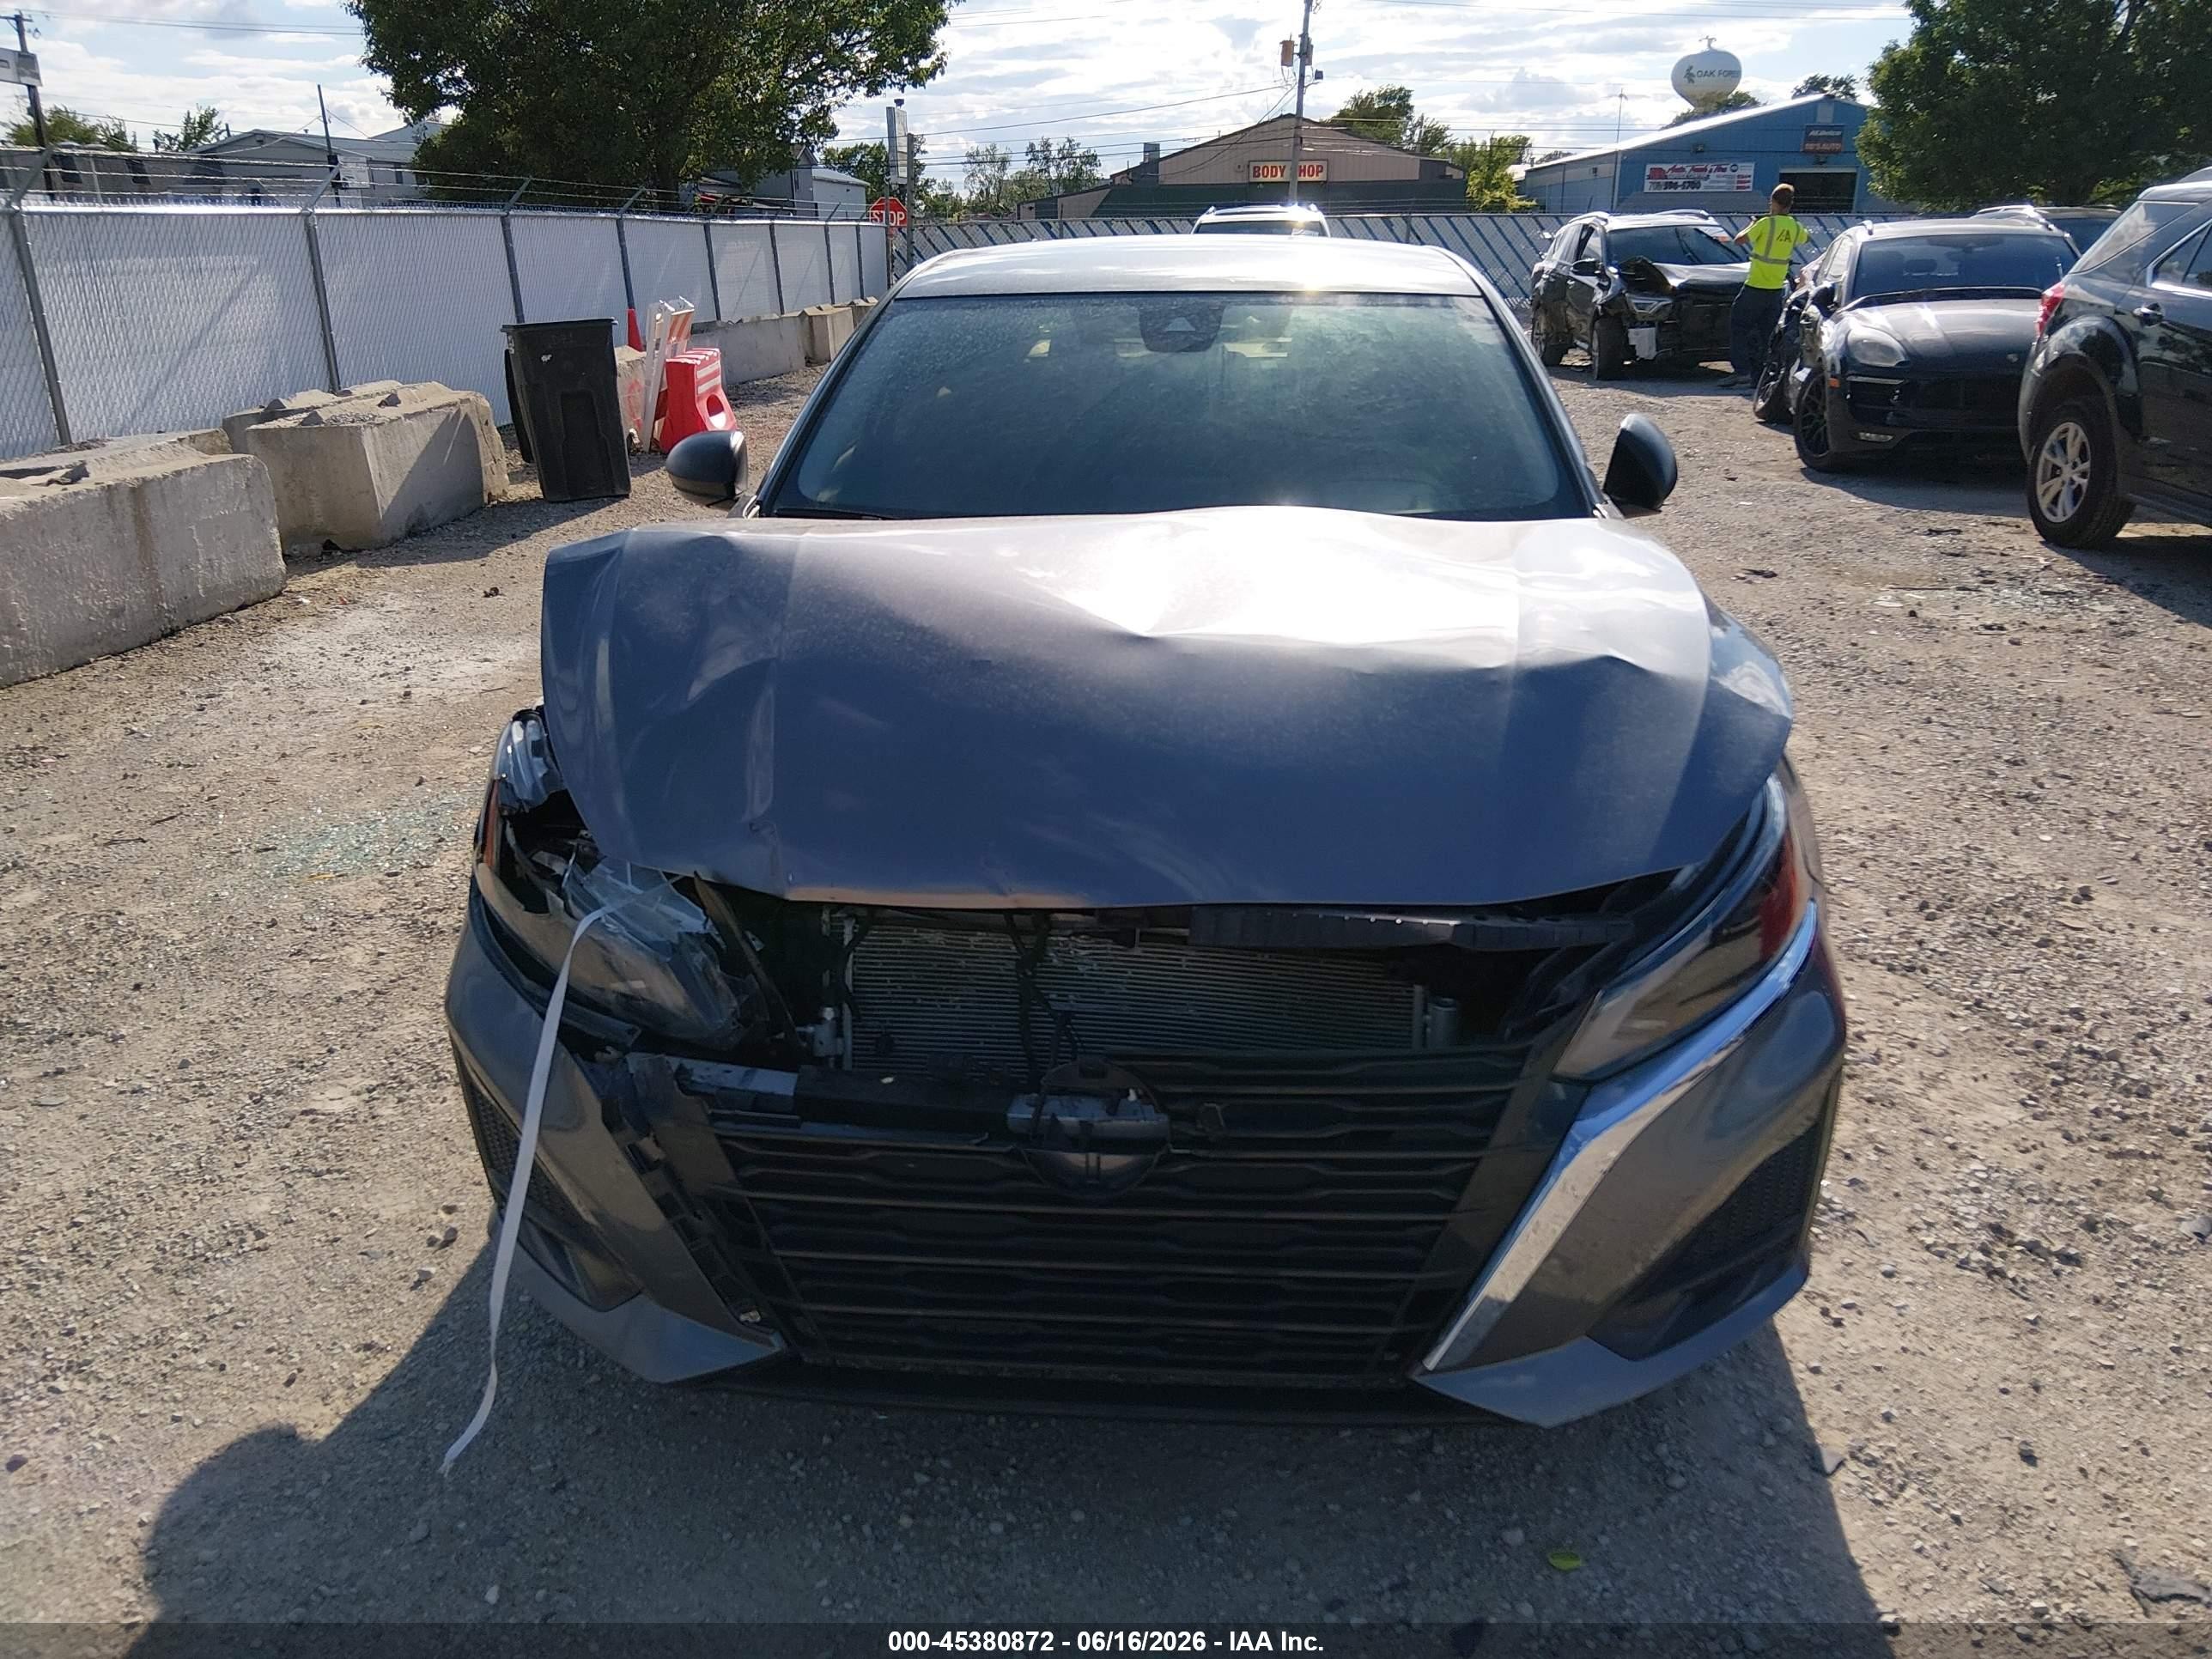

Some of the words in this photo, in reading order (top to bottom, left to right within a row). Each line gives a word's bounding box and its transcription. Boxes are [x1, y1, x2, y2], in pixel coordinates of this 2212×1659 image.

[1253, 165, 1286, 179] BODY
[1297, 164, 1324, 178] HOP
[872, 210, 905, 226] STOP
